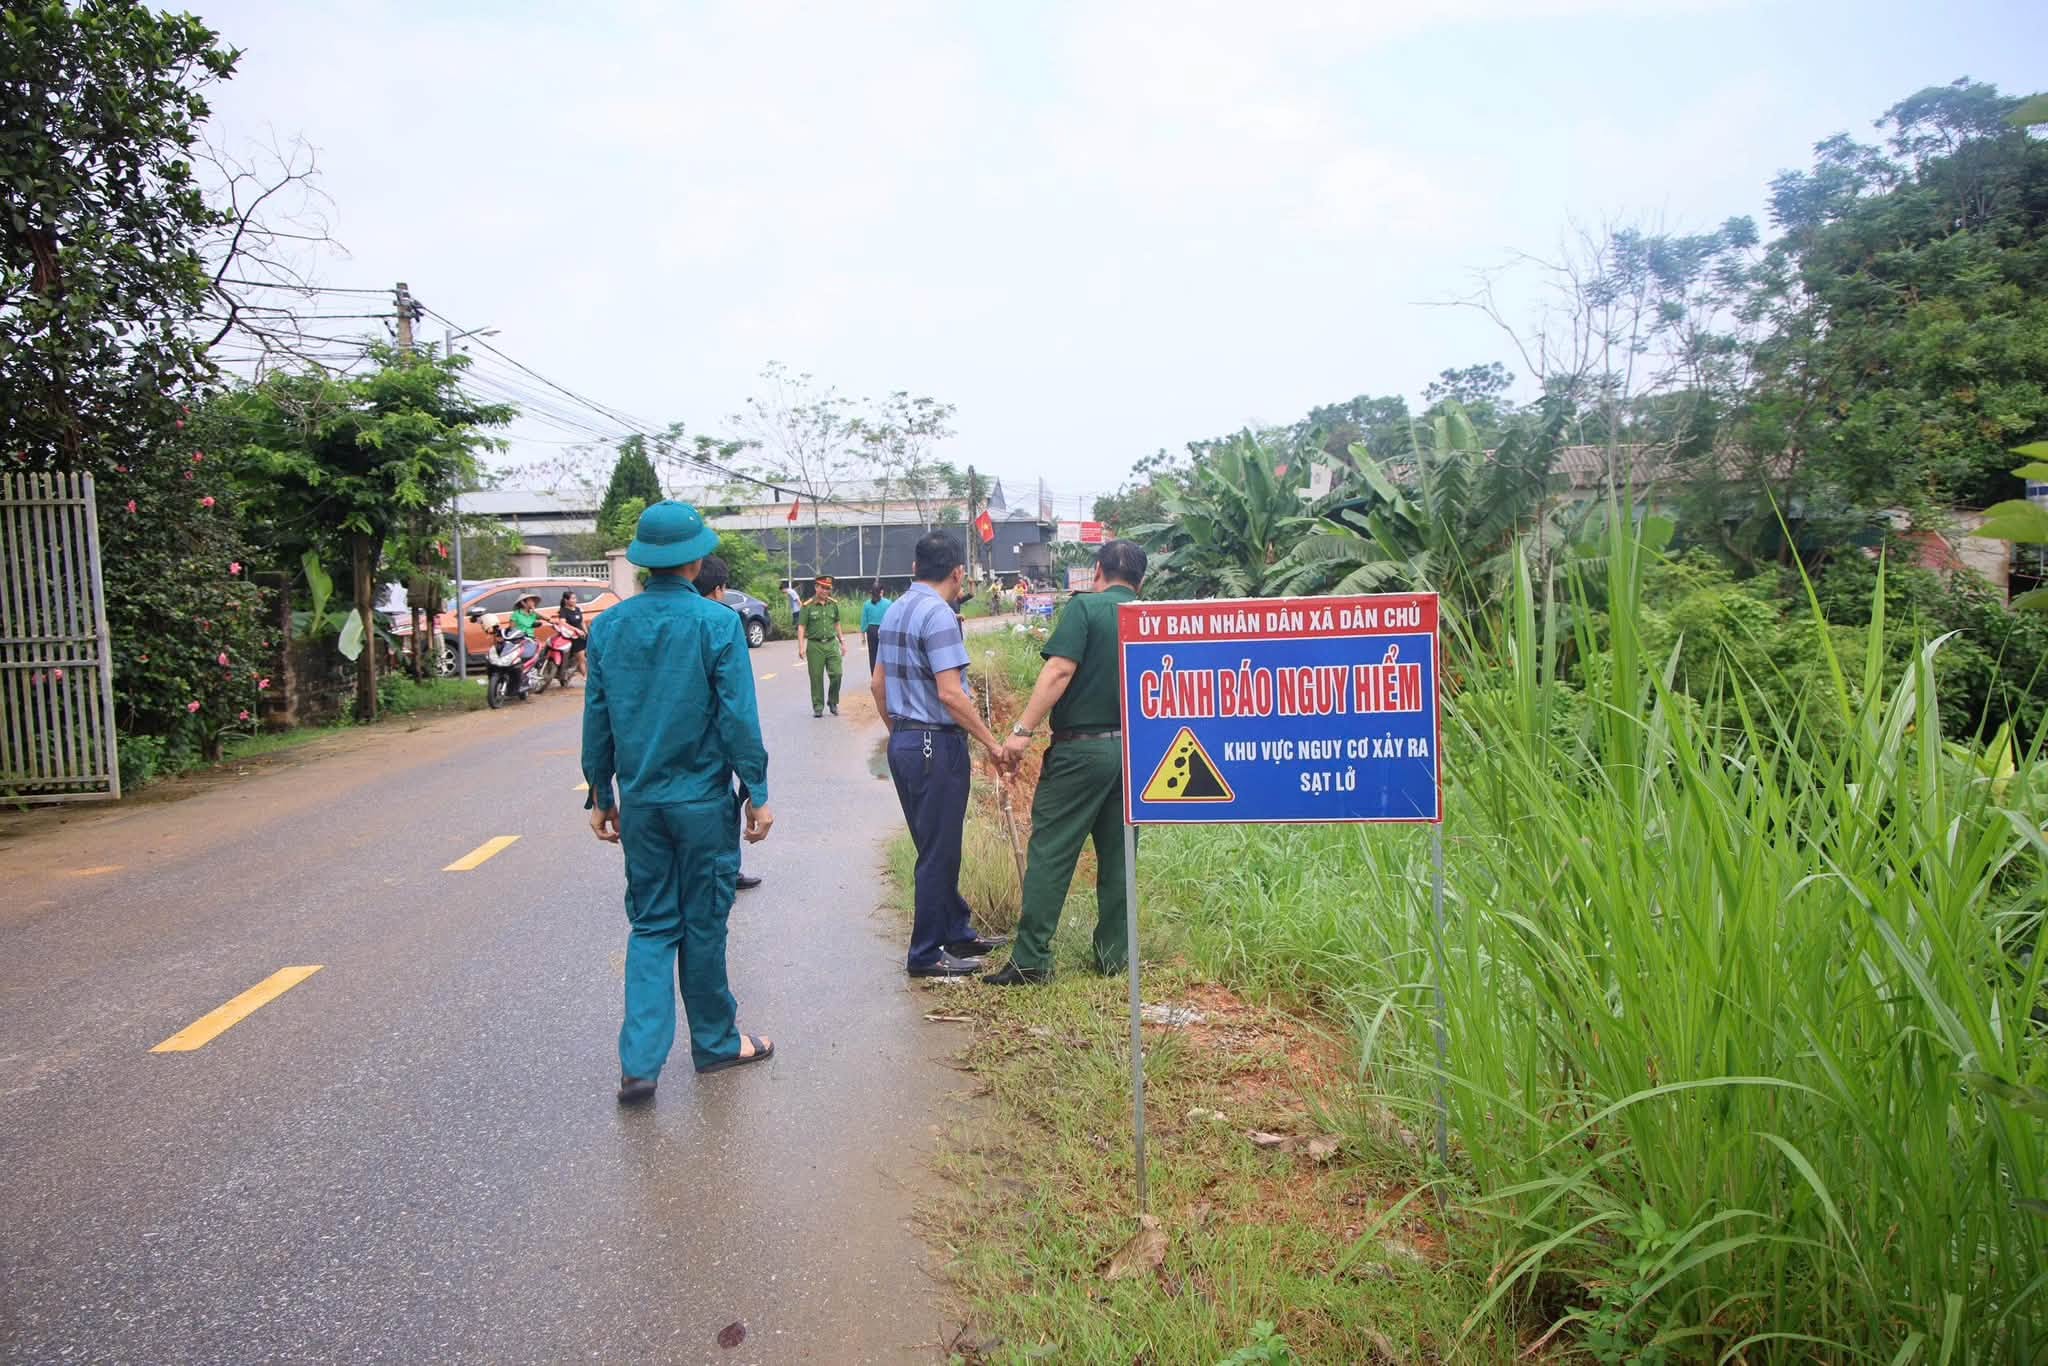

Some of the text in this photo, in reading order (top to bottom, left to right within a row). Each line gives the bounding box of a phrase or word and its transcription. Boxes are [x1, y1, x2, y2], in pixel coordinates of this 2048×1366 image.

[1139, 602, 1421, 636] ỦY BAN NHÂN DÂN XÃ DÂN CHỦ
[1140, 644, 1422, 719] CẢNH BÁO NGUY HIỂM
[1224, 732, 1428, 764] KHU VỰC NGUY CƠ XẢY RA
[1301, 765, 1356, 795] SẠT LỞ
